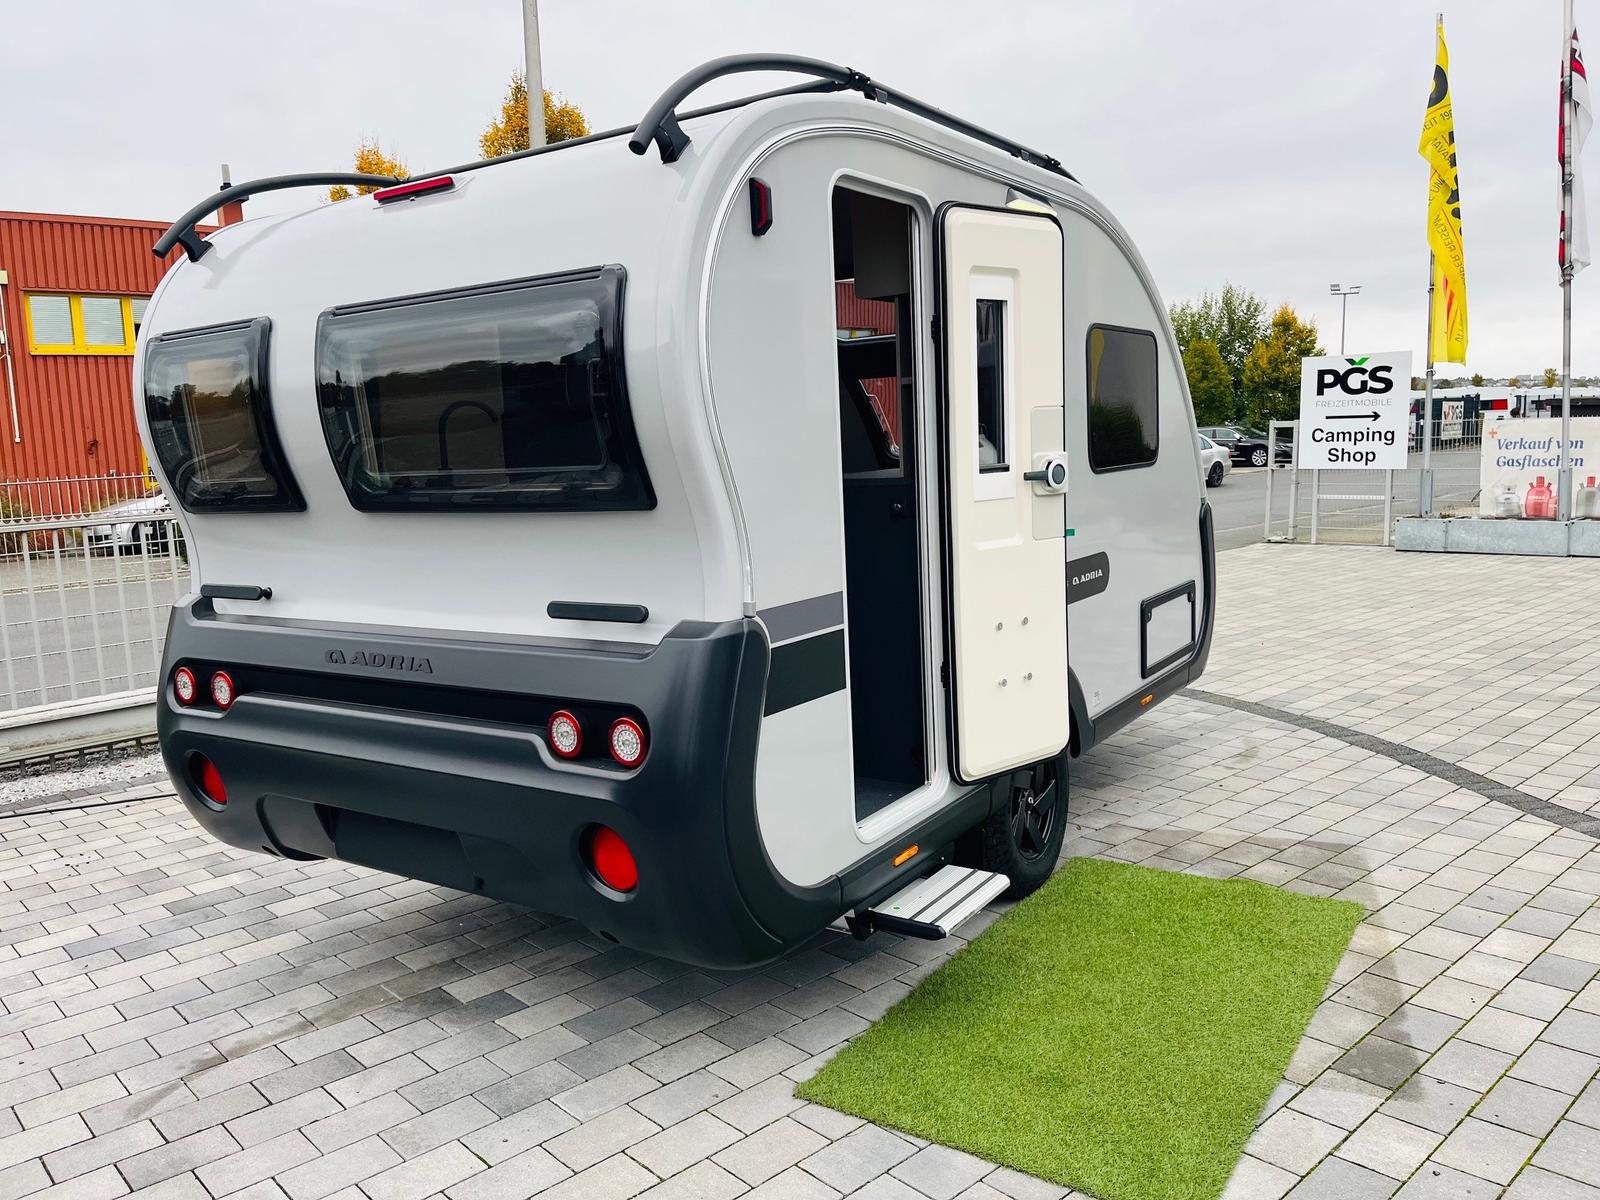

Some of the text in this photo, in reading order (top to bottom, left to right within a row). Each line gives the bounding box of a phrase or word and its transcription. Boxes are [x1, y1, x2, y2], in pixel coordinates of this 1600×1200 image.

[1316, 365, 1393, 396] PGS
[1315, 398, 1392, 408] FREIZEITMOBILE
[1312, 427, 1395, 446] Camping
[1497, 437, 1554, 453] Verkauf
[1328, 447, 1376, 466] Shop
[1080, 569, 1103, 583] ADRIA
[350, 651, 433, 674] ADRIA
